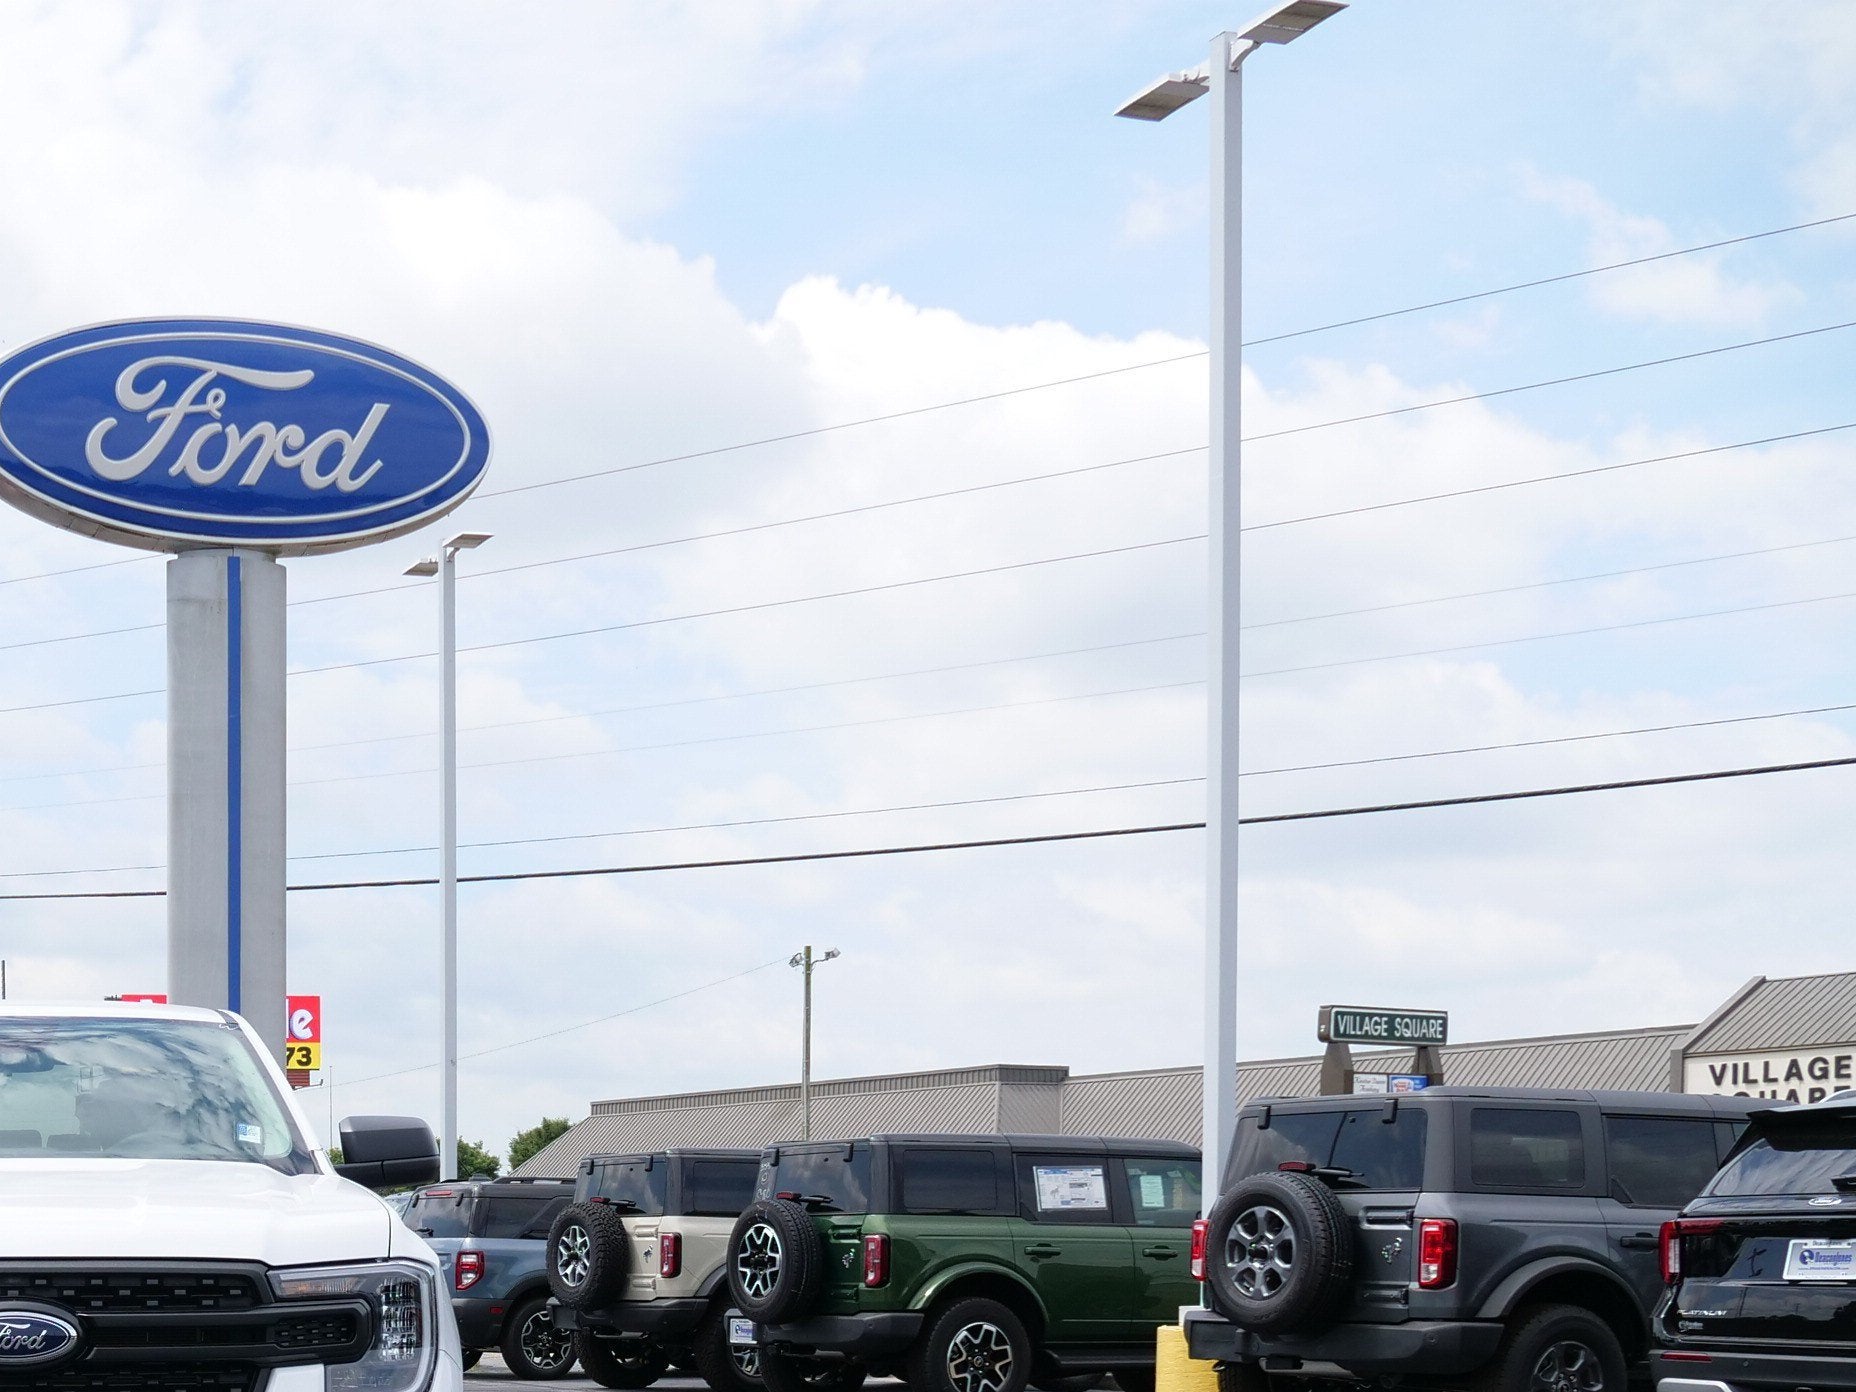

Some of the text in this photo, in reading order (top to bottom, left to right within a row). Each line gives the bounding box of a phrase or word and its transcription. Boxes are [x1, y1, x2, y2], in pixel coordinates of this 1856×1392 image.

[85, 355, 391, 492] Ford
[1337, 1014, 1443, 1039] VILLAGE SQUARE
[1708, 1054, 1853, 1087] VILLAGE
